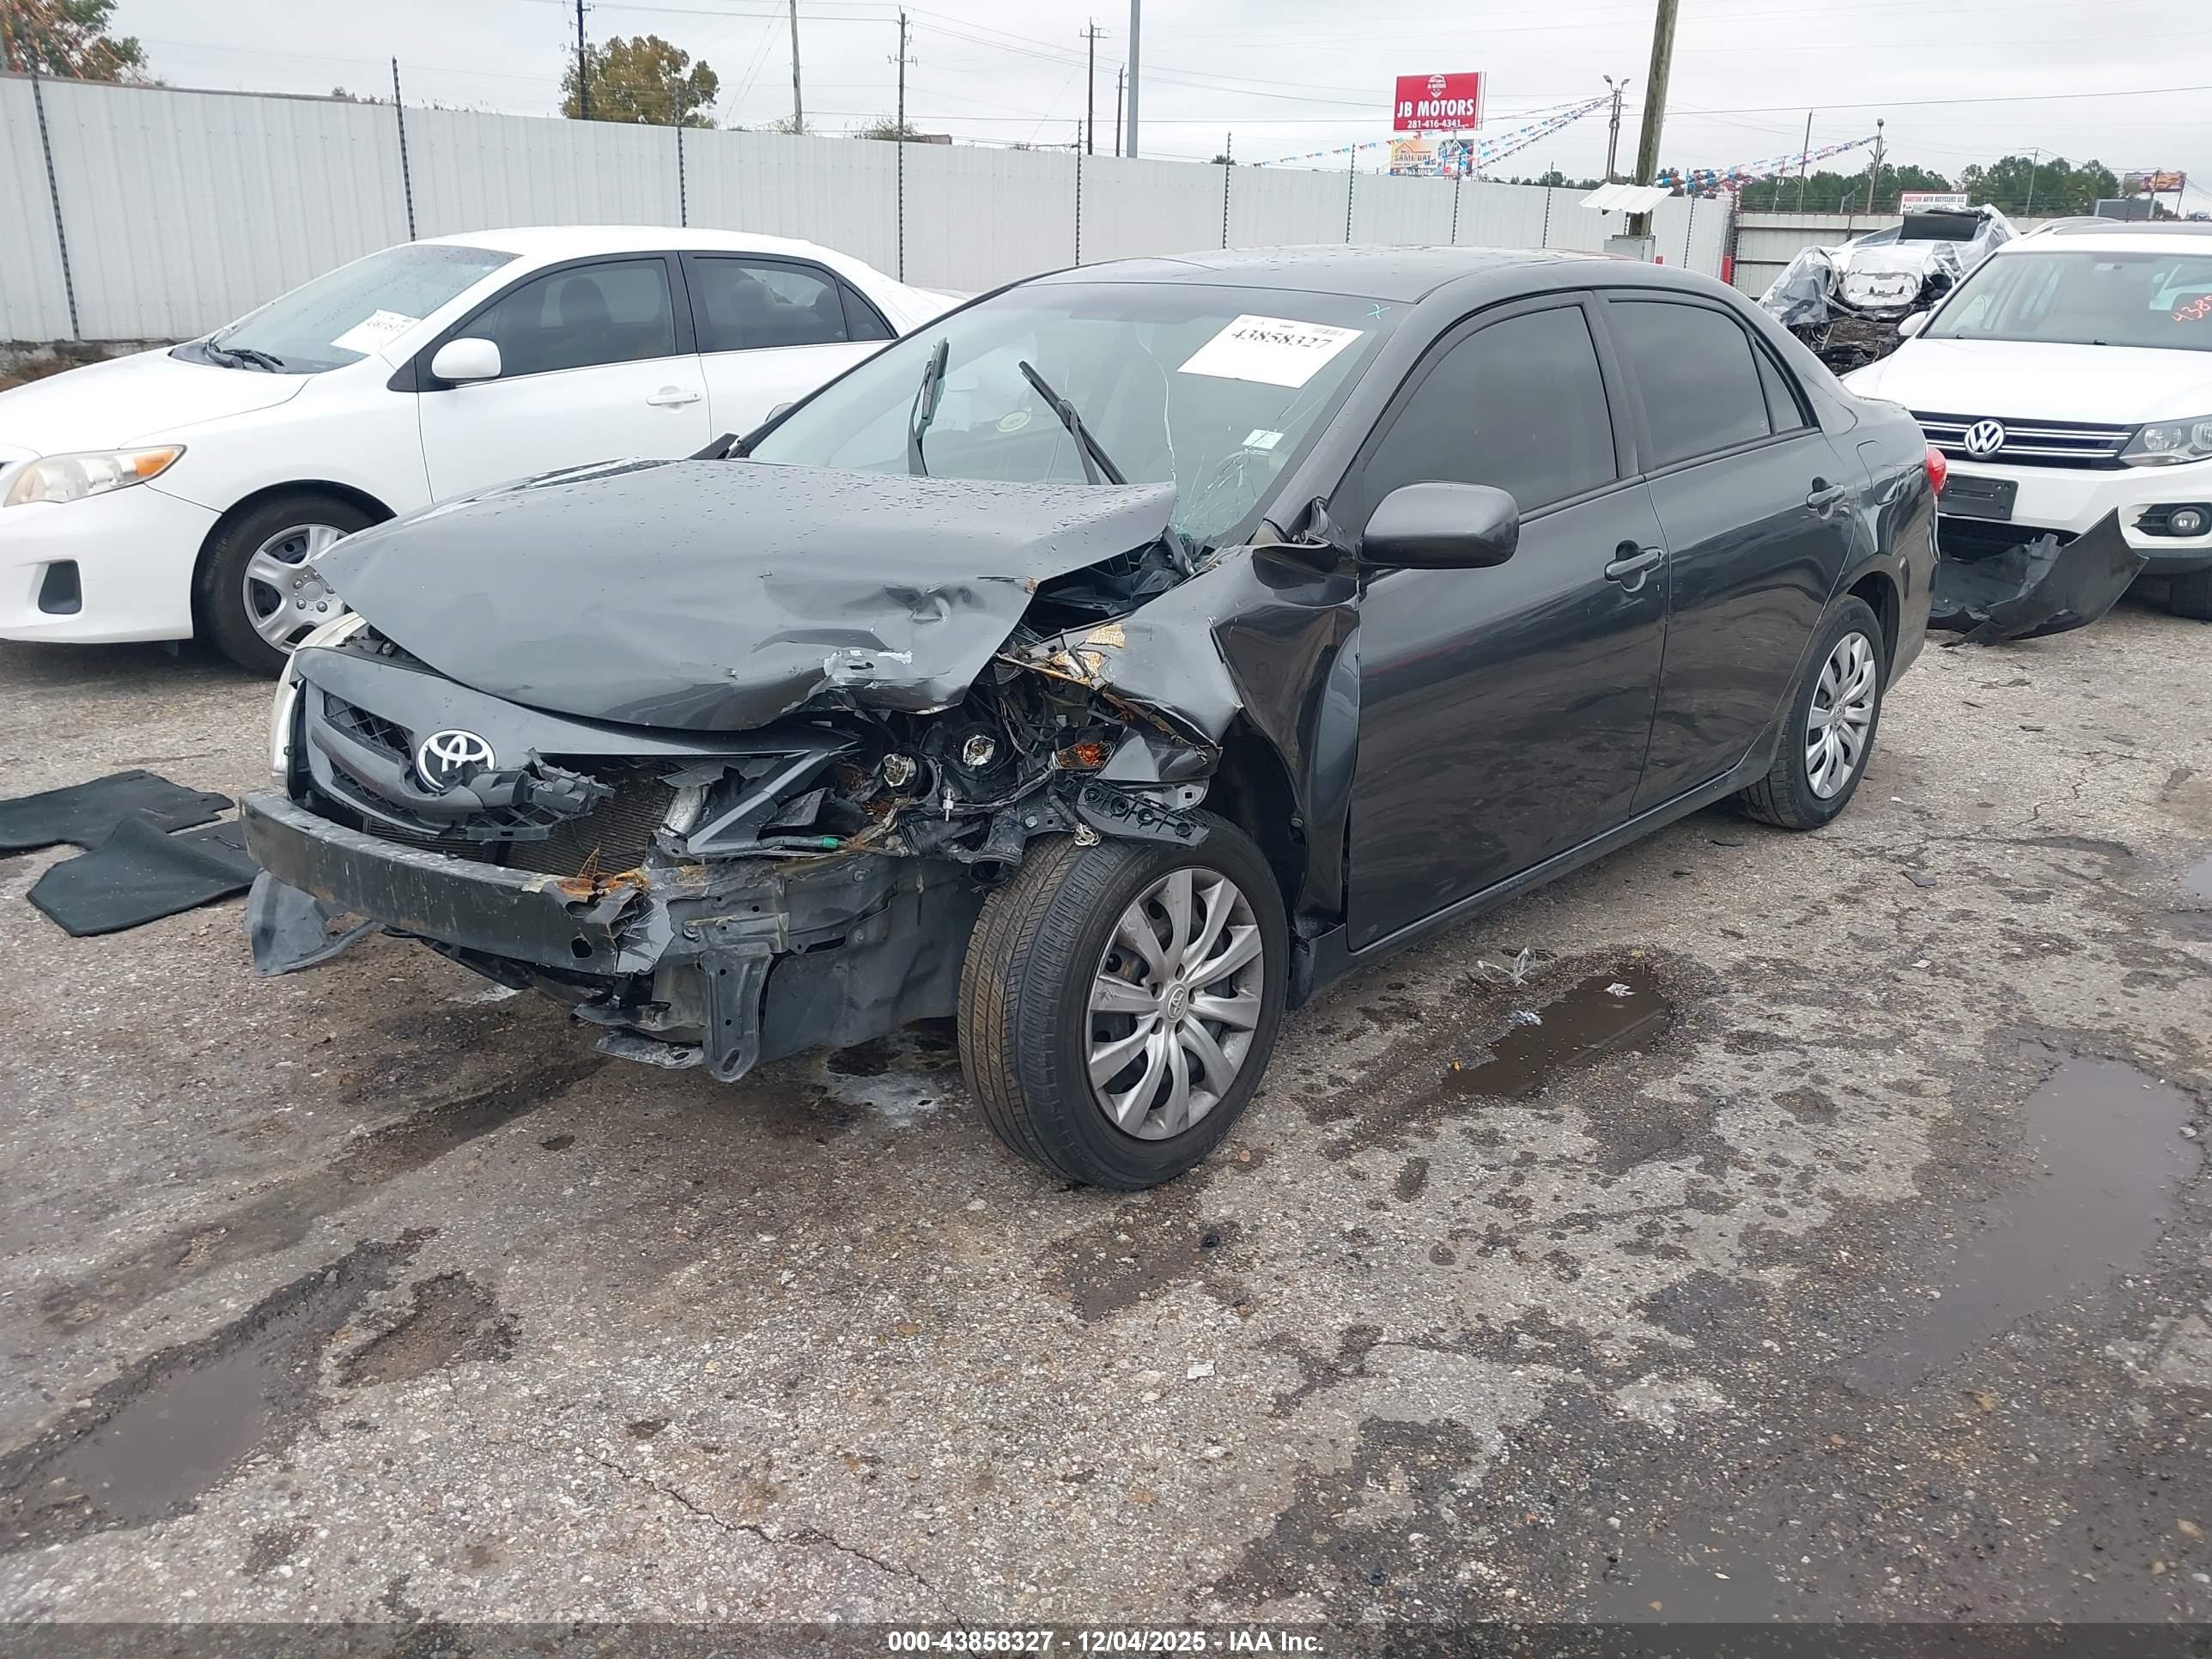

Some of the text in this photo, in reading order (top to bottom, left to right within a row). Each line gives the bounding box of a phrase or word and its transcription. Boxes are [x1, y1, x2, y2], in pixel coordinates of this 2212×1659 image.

[1398, 98, 1474, 118] JB MOTORS
[1407, 118, 1461, 129] 281-416-4341
[1231, 329, 1334, 349] 43858327
